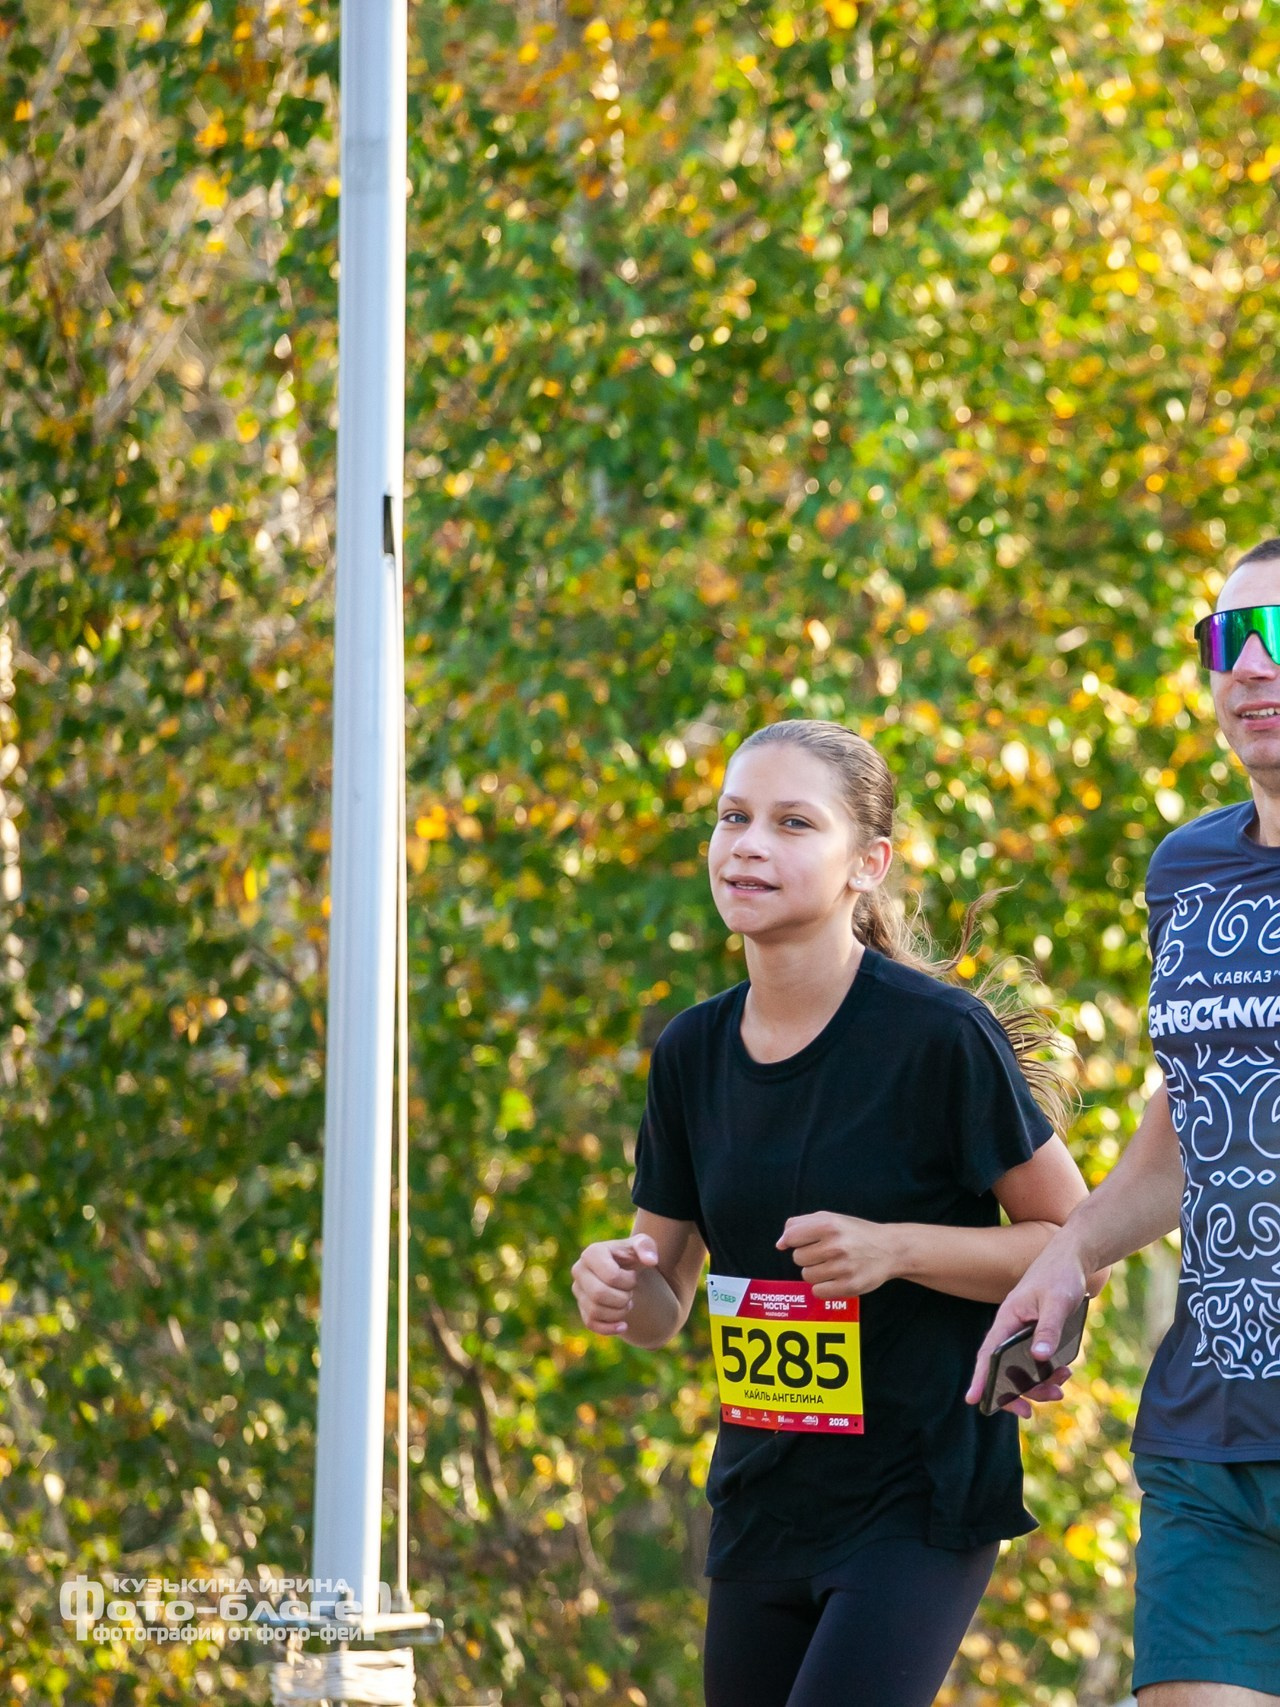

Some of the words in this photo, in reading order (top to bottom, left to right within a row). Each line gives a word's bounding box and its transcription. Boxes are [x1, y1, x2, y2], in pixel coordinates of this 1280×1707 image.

[1213, 969, 1272, 985] КАВКАЗ
[750, 1292, 805, 1302] КРАСНОЯРСКИЕ
[763, 1301, 790, 1310] МОСТЫ
[825, 1300, 831, 1309] 5
[832, 1300, 847, 1309] КМ
[721, 1325, 849, 1390] 5285
[744, 1389, 771, 1401] КАЙЛЬ
[772, 1391, 824, 1404] АНГЕЛИНА
